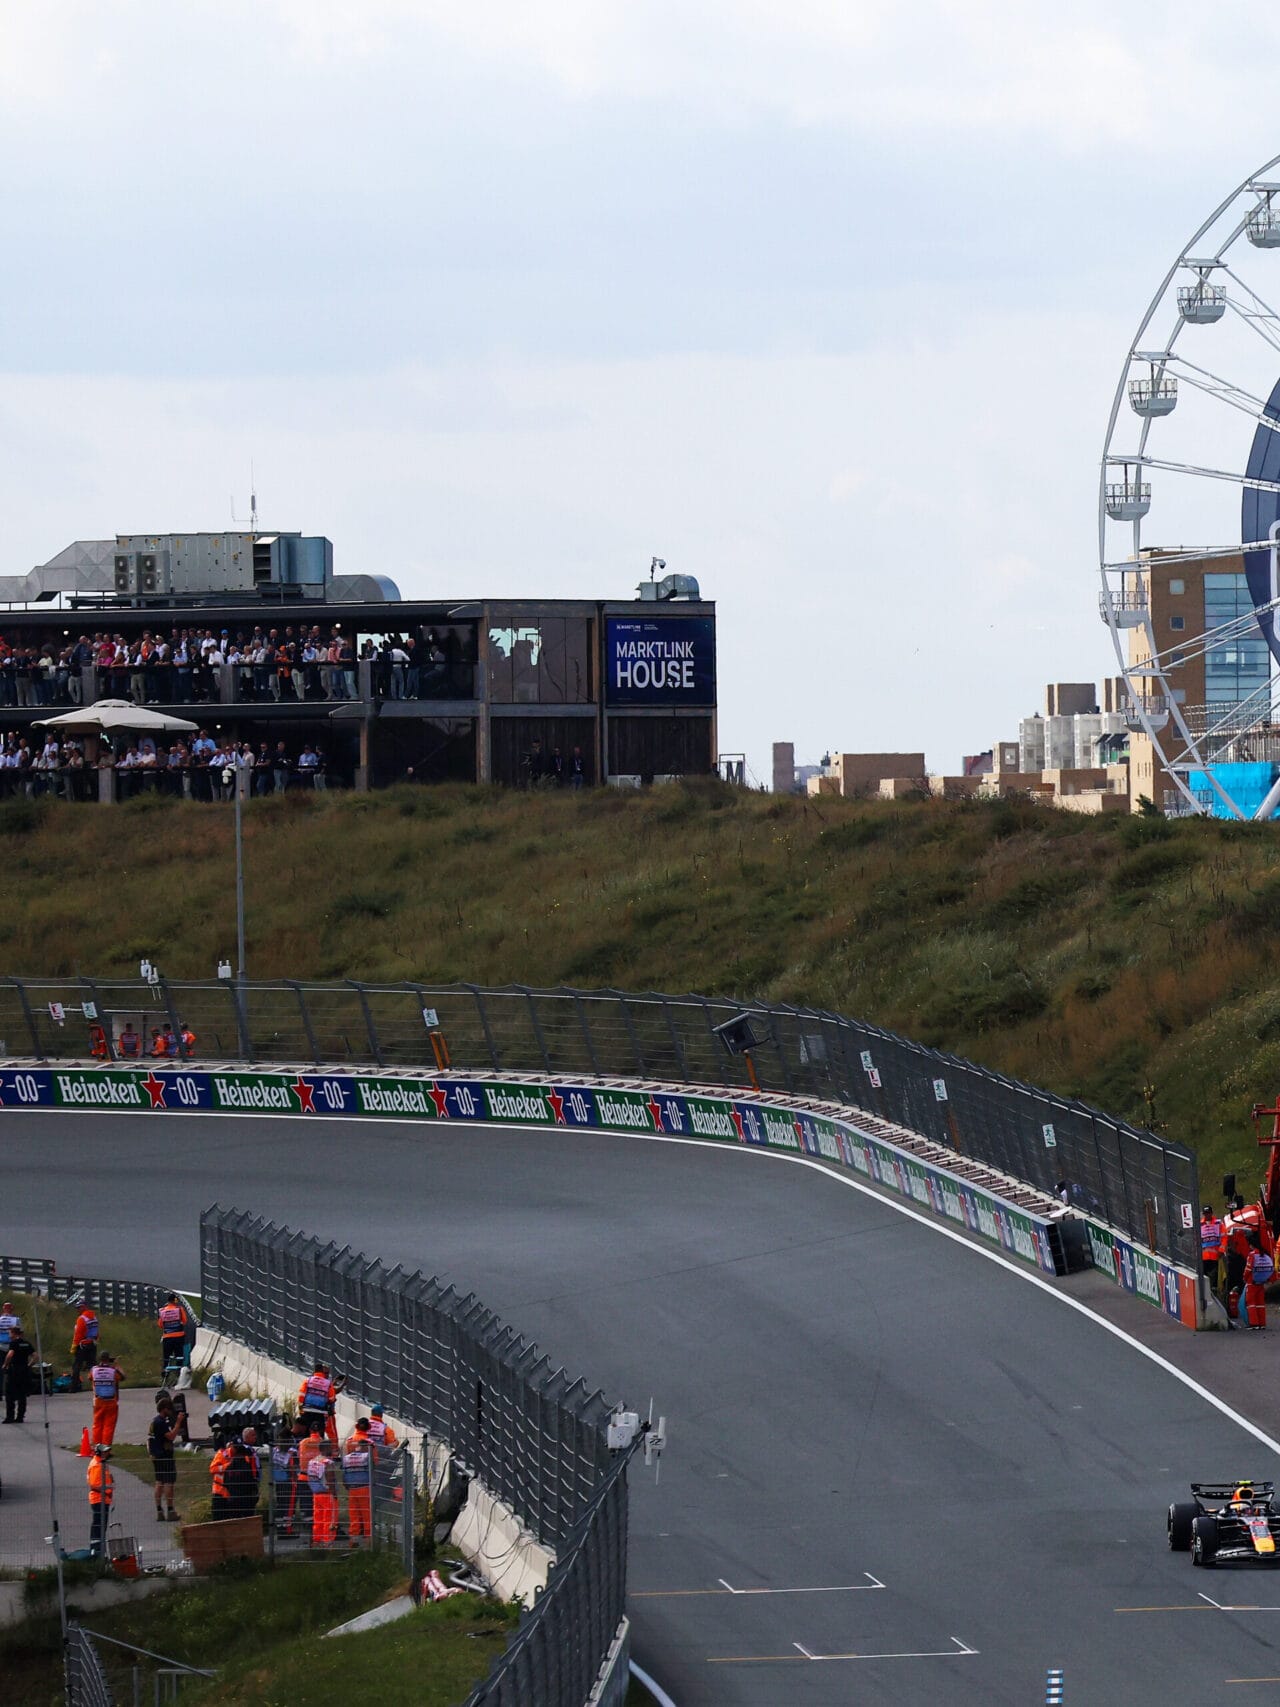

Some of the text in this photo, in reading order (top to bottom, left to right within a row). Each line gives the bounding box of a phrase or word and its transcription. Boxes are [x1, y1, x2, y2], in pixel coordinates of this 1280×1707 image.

[616, 641, 694, 658] MARKTLINK
[616, 660, 695, 688] HOUSE
[57, 1075, 142, 1104] Heineken
[214, 1078, 292, 1108] Heineken
[358, 1083, 429, 1113] Heineken
[485, 1088, 549, 1119] Heineken
[596, 1094, 650, 1127] Heineken
[687, 1104, 735, 1136] Heineken
